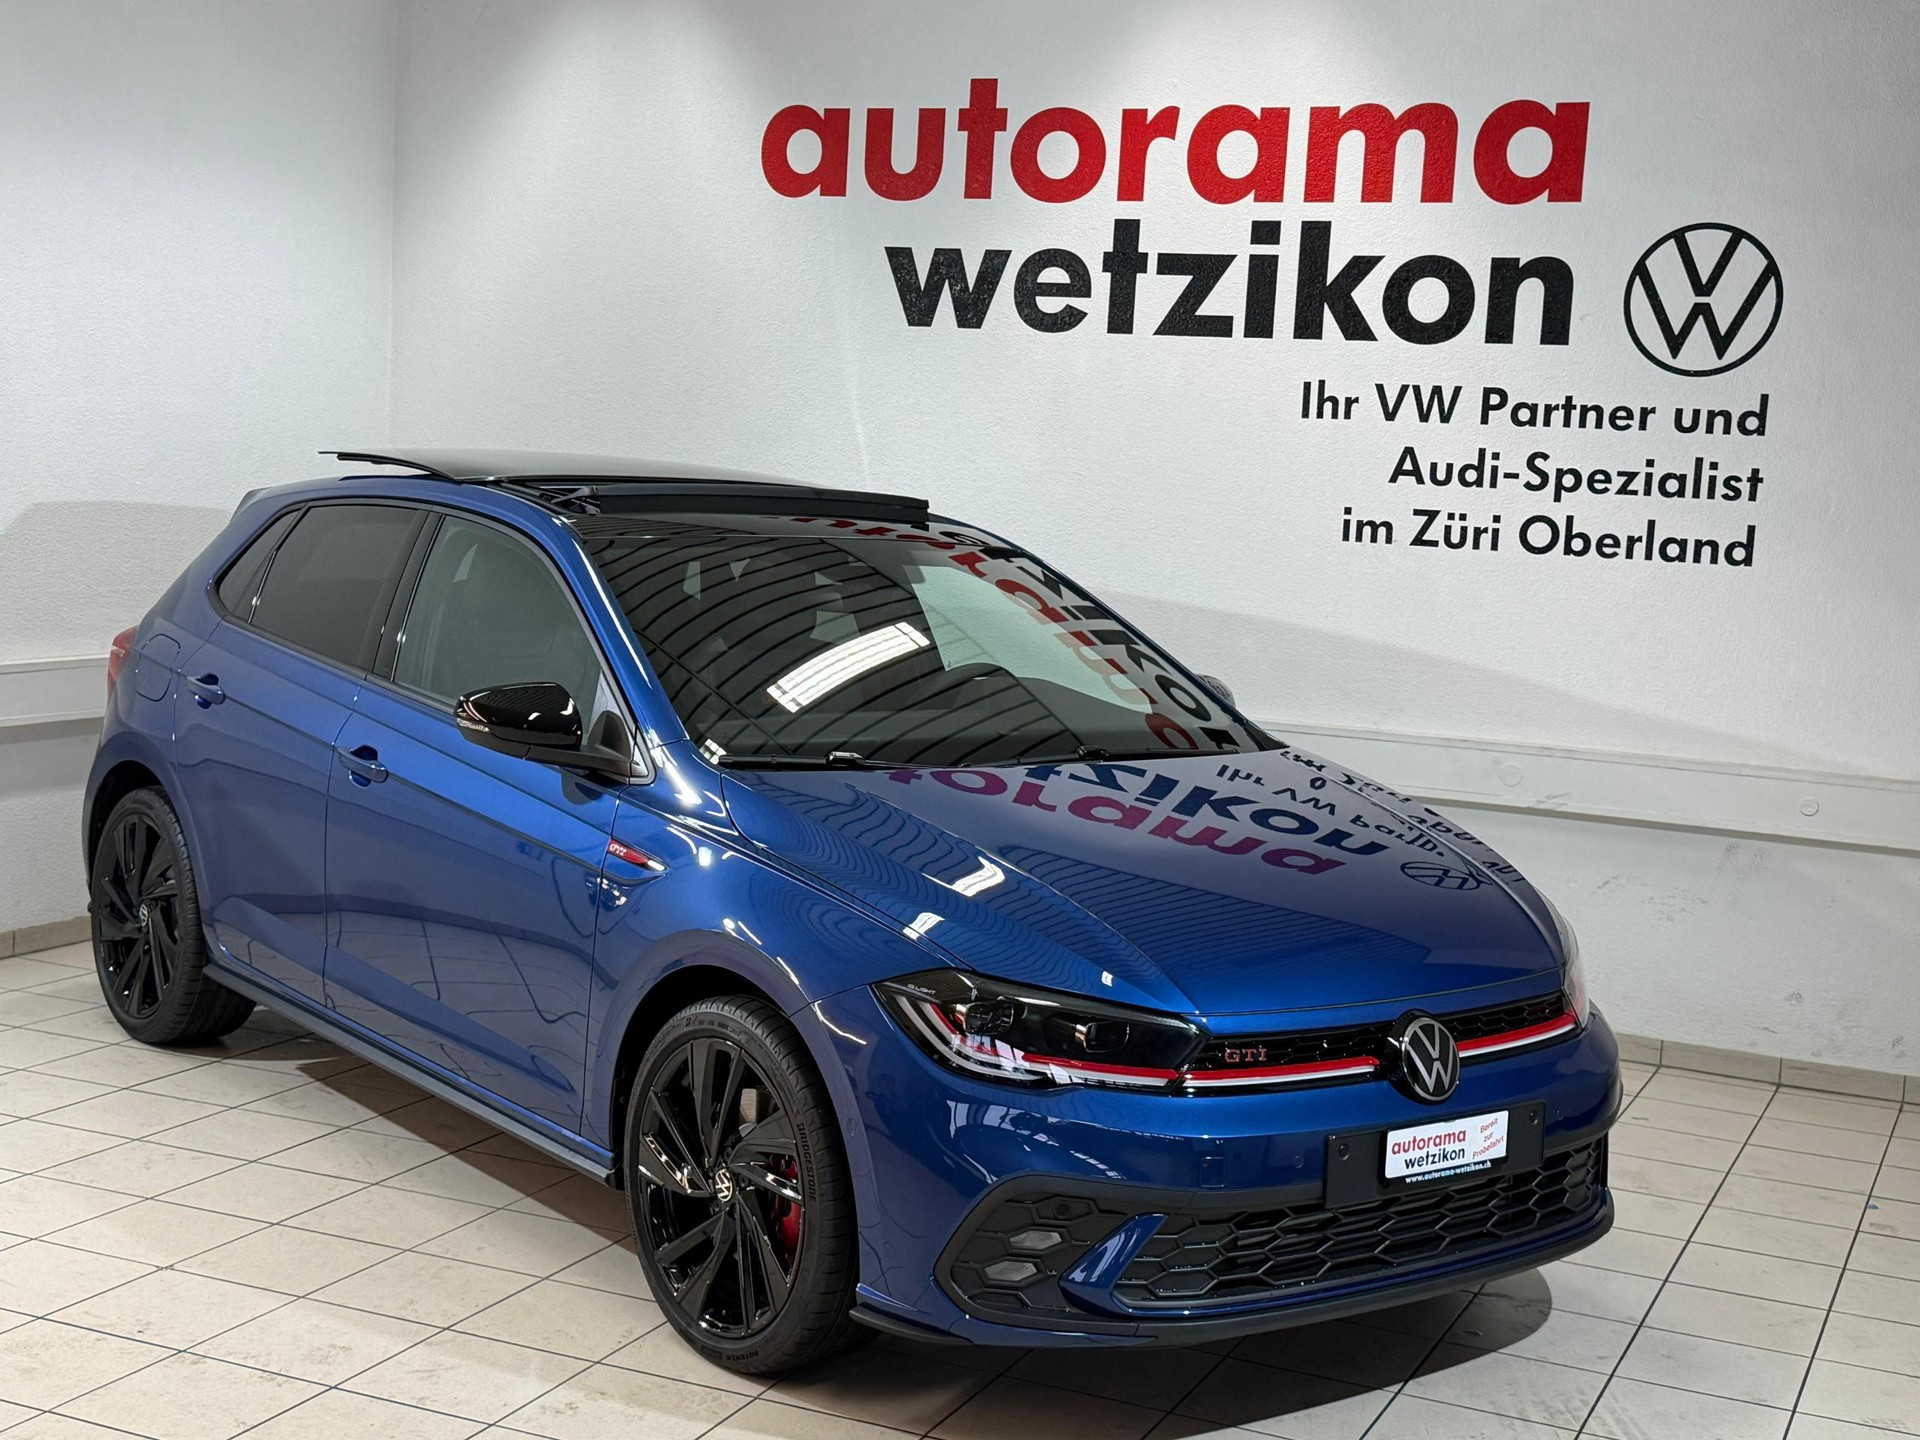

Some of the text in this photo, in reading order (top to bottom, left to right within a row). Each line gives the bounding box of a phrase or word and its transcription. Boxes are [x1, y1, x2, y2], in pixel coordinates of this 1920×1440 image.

[761, 79, 1588, 205] autorama
[885, 218, 1574, 346] wetzikon
[1301, 379, 1770, 437] Ihr VW Partner und
[1388, 446, 1765, 503] Audi-Spezialist
[1342, 506, 1756, 567] im Züri Oberland
[1224, 1048, 1267, 1063] GTI
[1480, 1118, 1498, 1133] Bereit
[1484, 1132, 1494, 1142] zur
[1391, 1129, 1467, 1155] autorama
[1472, 1135, 1504, 1160] Probefahrt
[1404, 1147, 1466, 1170] wetzikon
[1405, 1160, 1492, 1184] www.autorama-wetzikon.ch
